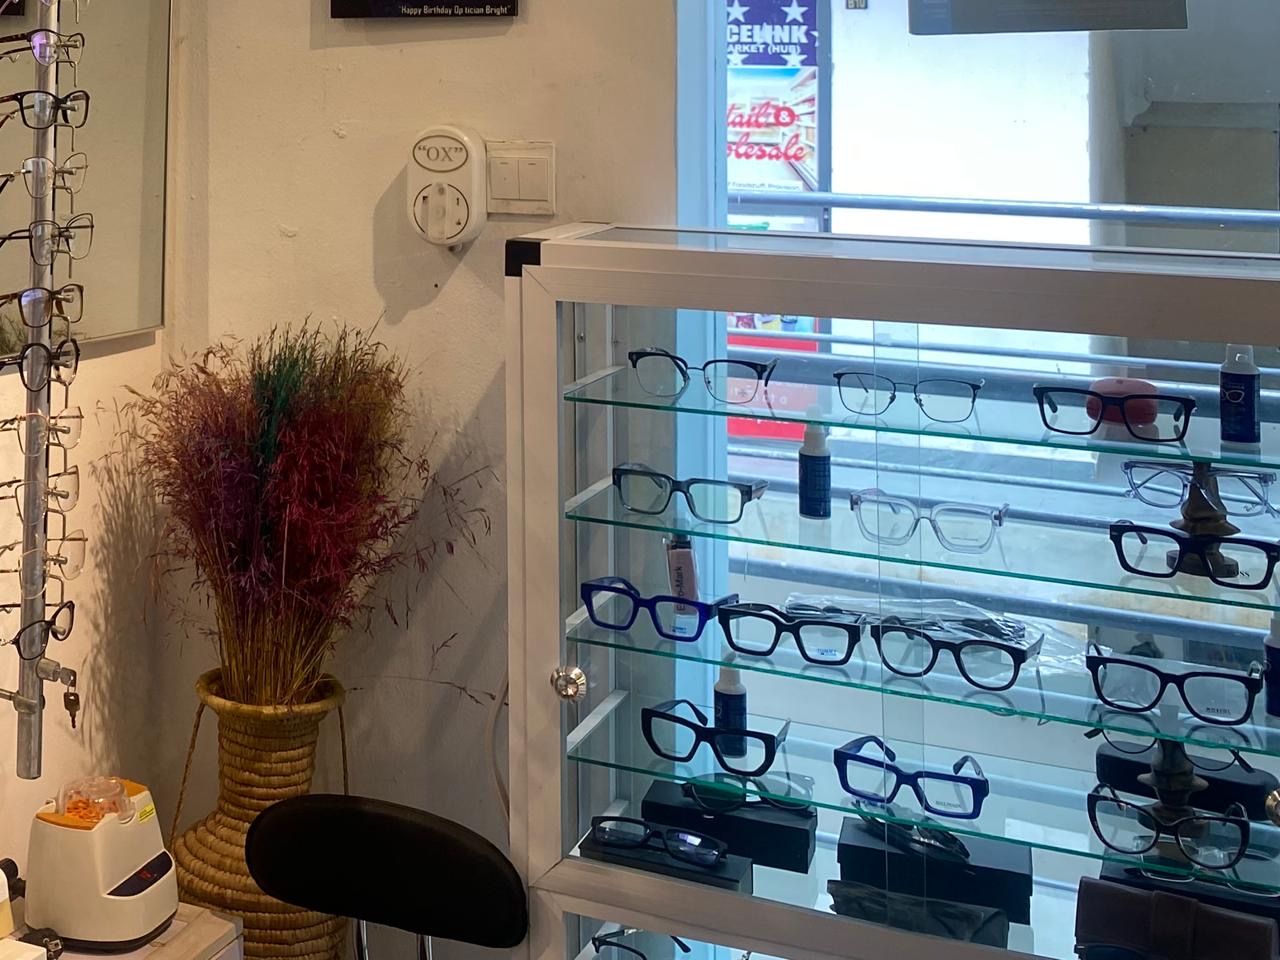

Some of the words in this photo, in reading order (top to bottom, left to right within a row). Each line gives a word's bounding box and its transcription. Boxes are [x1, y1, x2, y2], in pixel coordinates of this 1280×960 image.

[423, 5, 452, 16] Birthday
[727, 24, 809, 44] CELINK
[727, 44, 766, 54] ARKET
[727, 101, 772, 129] tail
[727, 131, 806, 162] lesale
[674, 565, 686, 612] Eo-Mark
